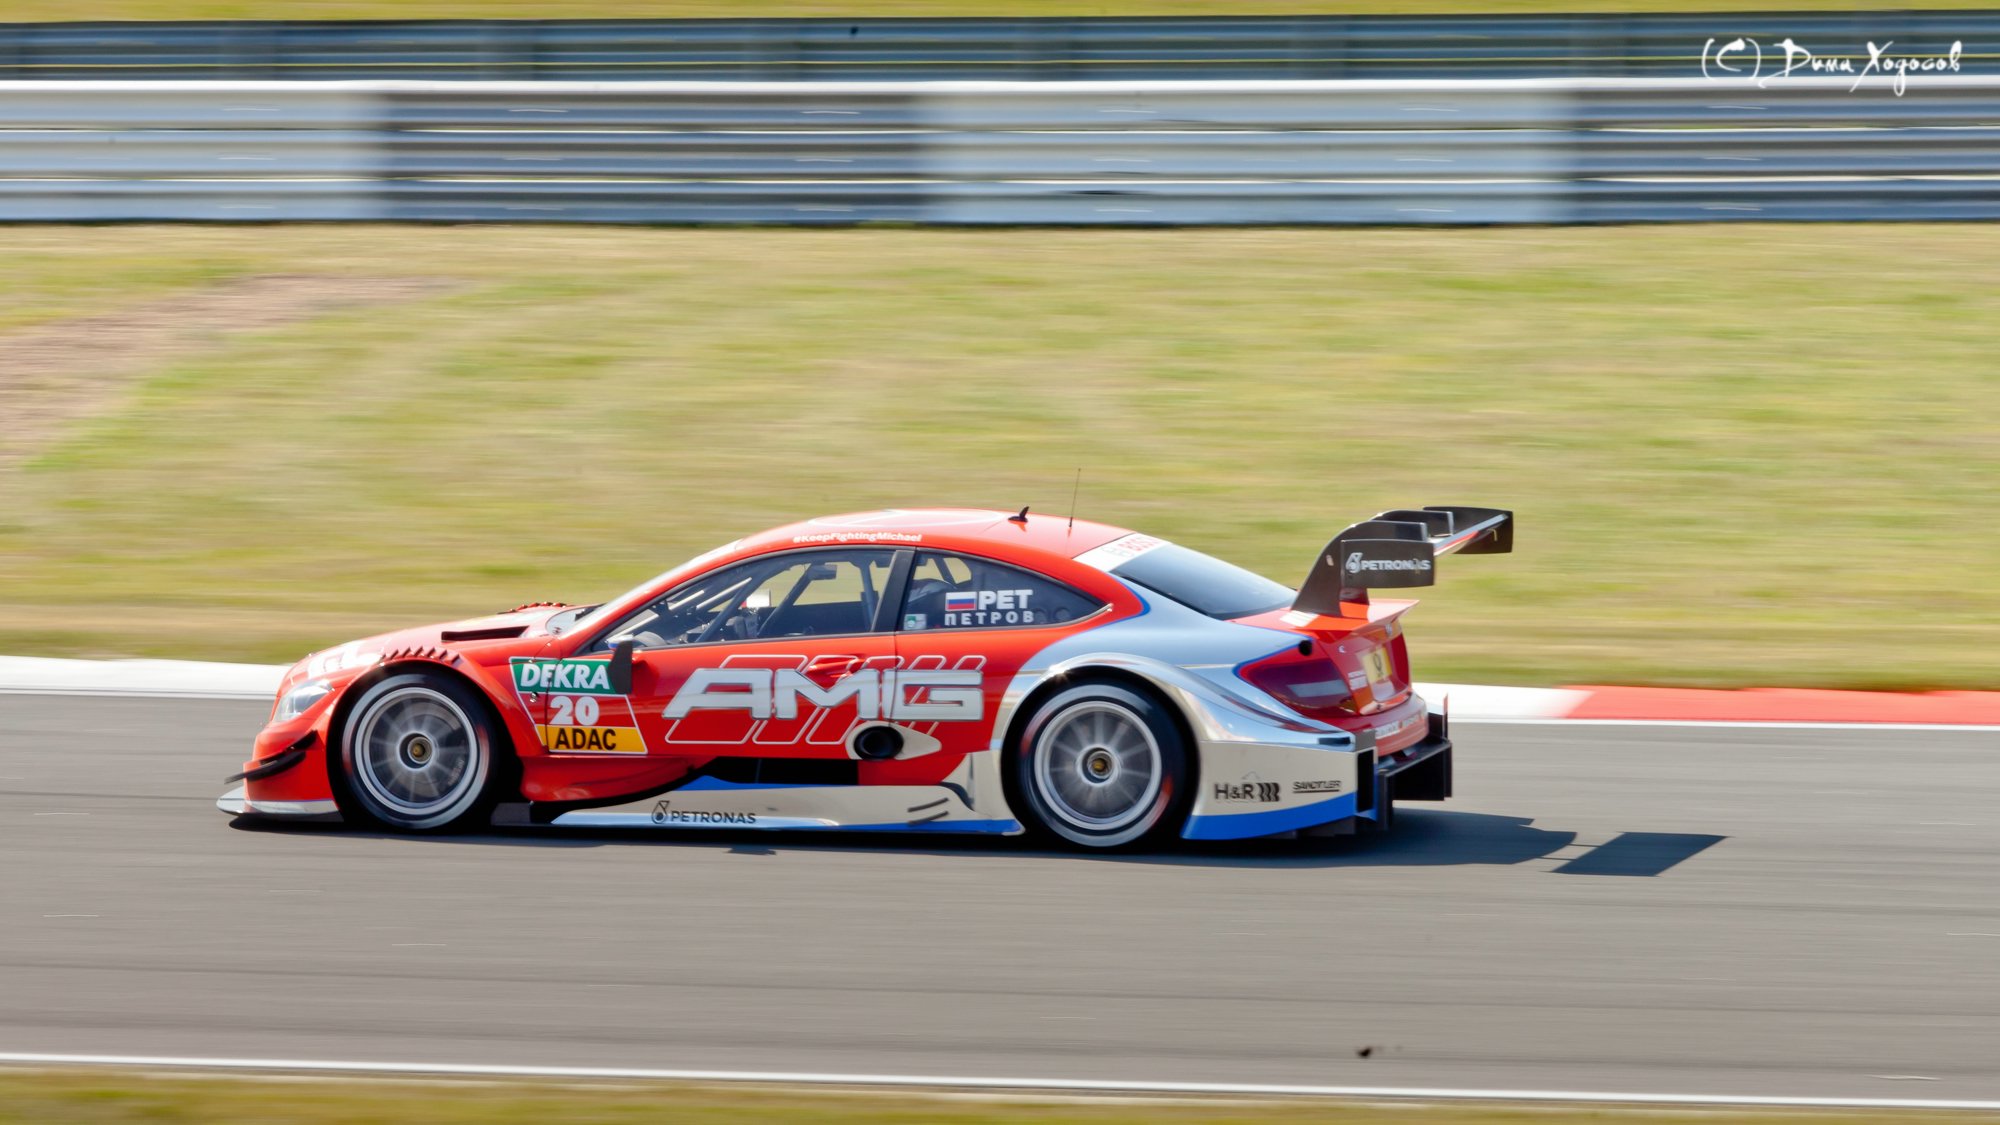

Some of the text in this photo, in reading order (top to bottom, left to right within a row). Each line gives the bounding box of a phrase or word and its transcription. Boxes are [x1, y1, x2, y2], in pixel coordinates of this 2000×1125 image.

[944, 611, 1035, 626] ПЕТРОВ
[520, 664, 611, 690] DEKRA
[662, 667, 984, 721] AMG
[550, 695, 600, 726] 20
[554, 728, 617, 751] ADAC
[1214, 783, 1255, 800] H&R
[669, 810, 757, 824] PETRONAS
